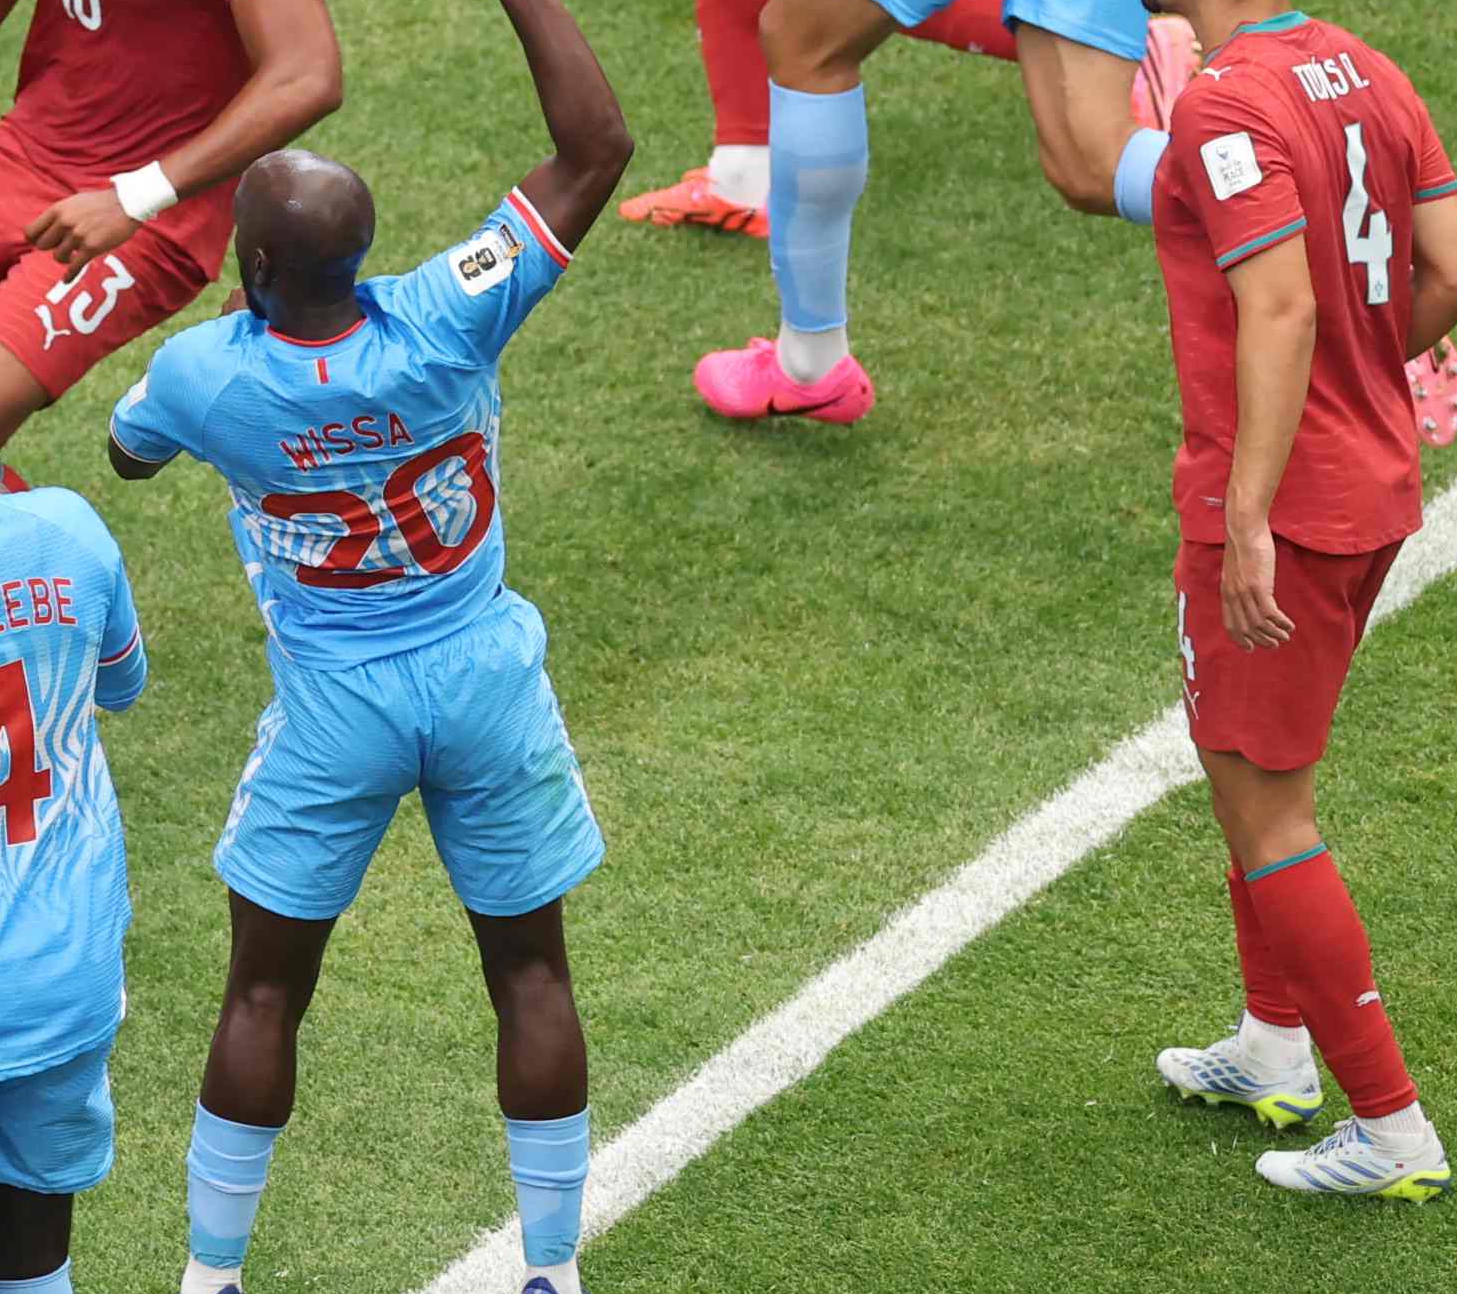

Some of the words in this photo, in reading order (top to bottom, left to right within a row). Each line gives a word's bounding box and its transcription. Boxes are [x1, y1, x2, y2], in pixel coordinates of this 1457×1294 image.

[1342, 121, 1394, 306] 4
[261, 431, 498, 591] 20
[279, 410, 416, 474] WISSA
